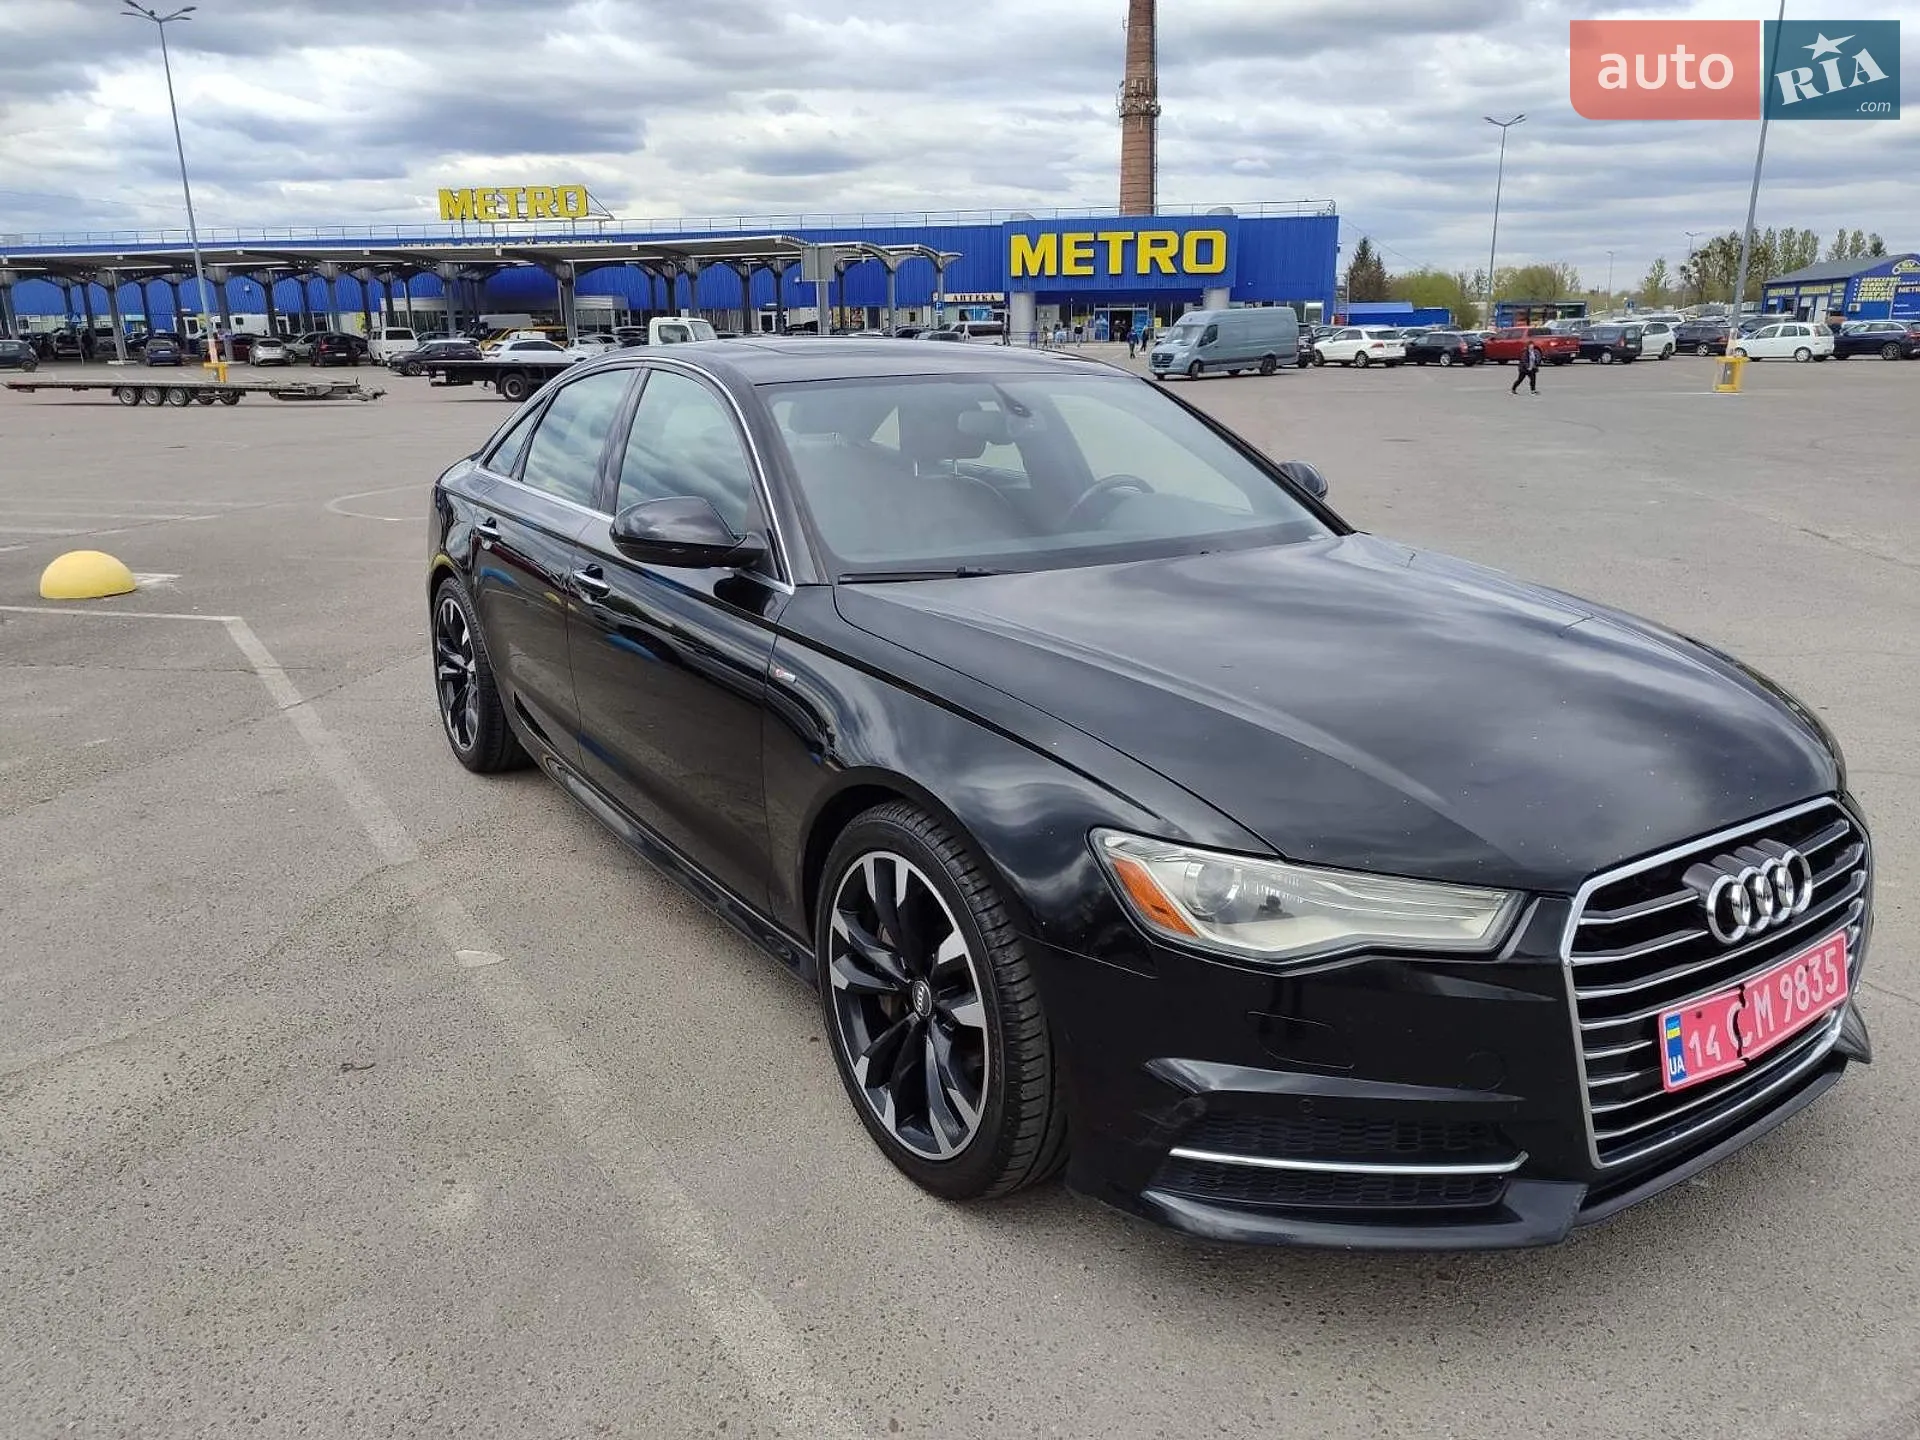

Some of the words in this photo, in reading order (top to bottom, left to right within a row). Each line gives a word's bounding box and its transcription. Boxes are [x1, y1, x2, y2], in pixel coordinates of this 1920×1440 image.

[438, 184, 589, 221] METRO
[1010, 230, 1227, 277] METRO
[1689, 1024, 1721, 1067] 14
[1726, 984, 1775, 1049] CM
[1779, 946, 1839, 1023] 9835
[1668, 1057, 1686, 1075] UA
